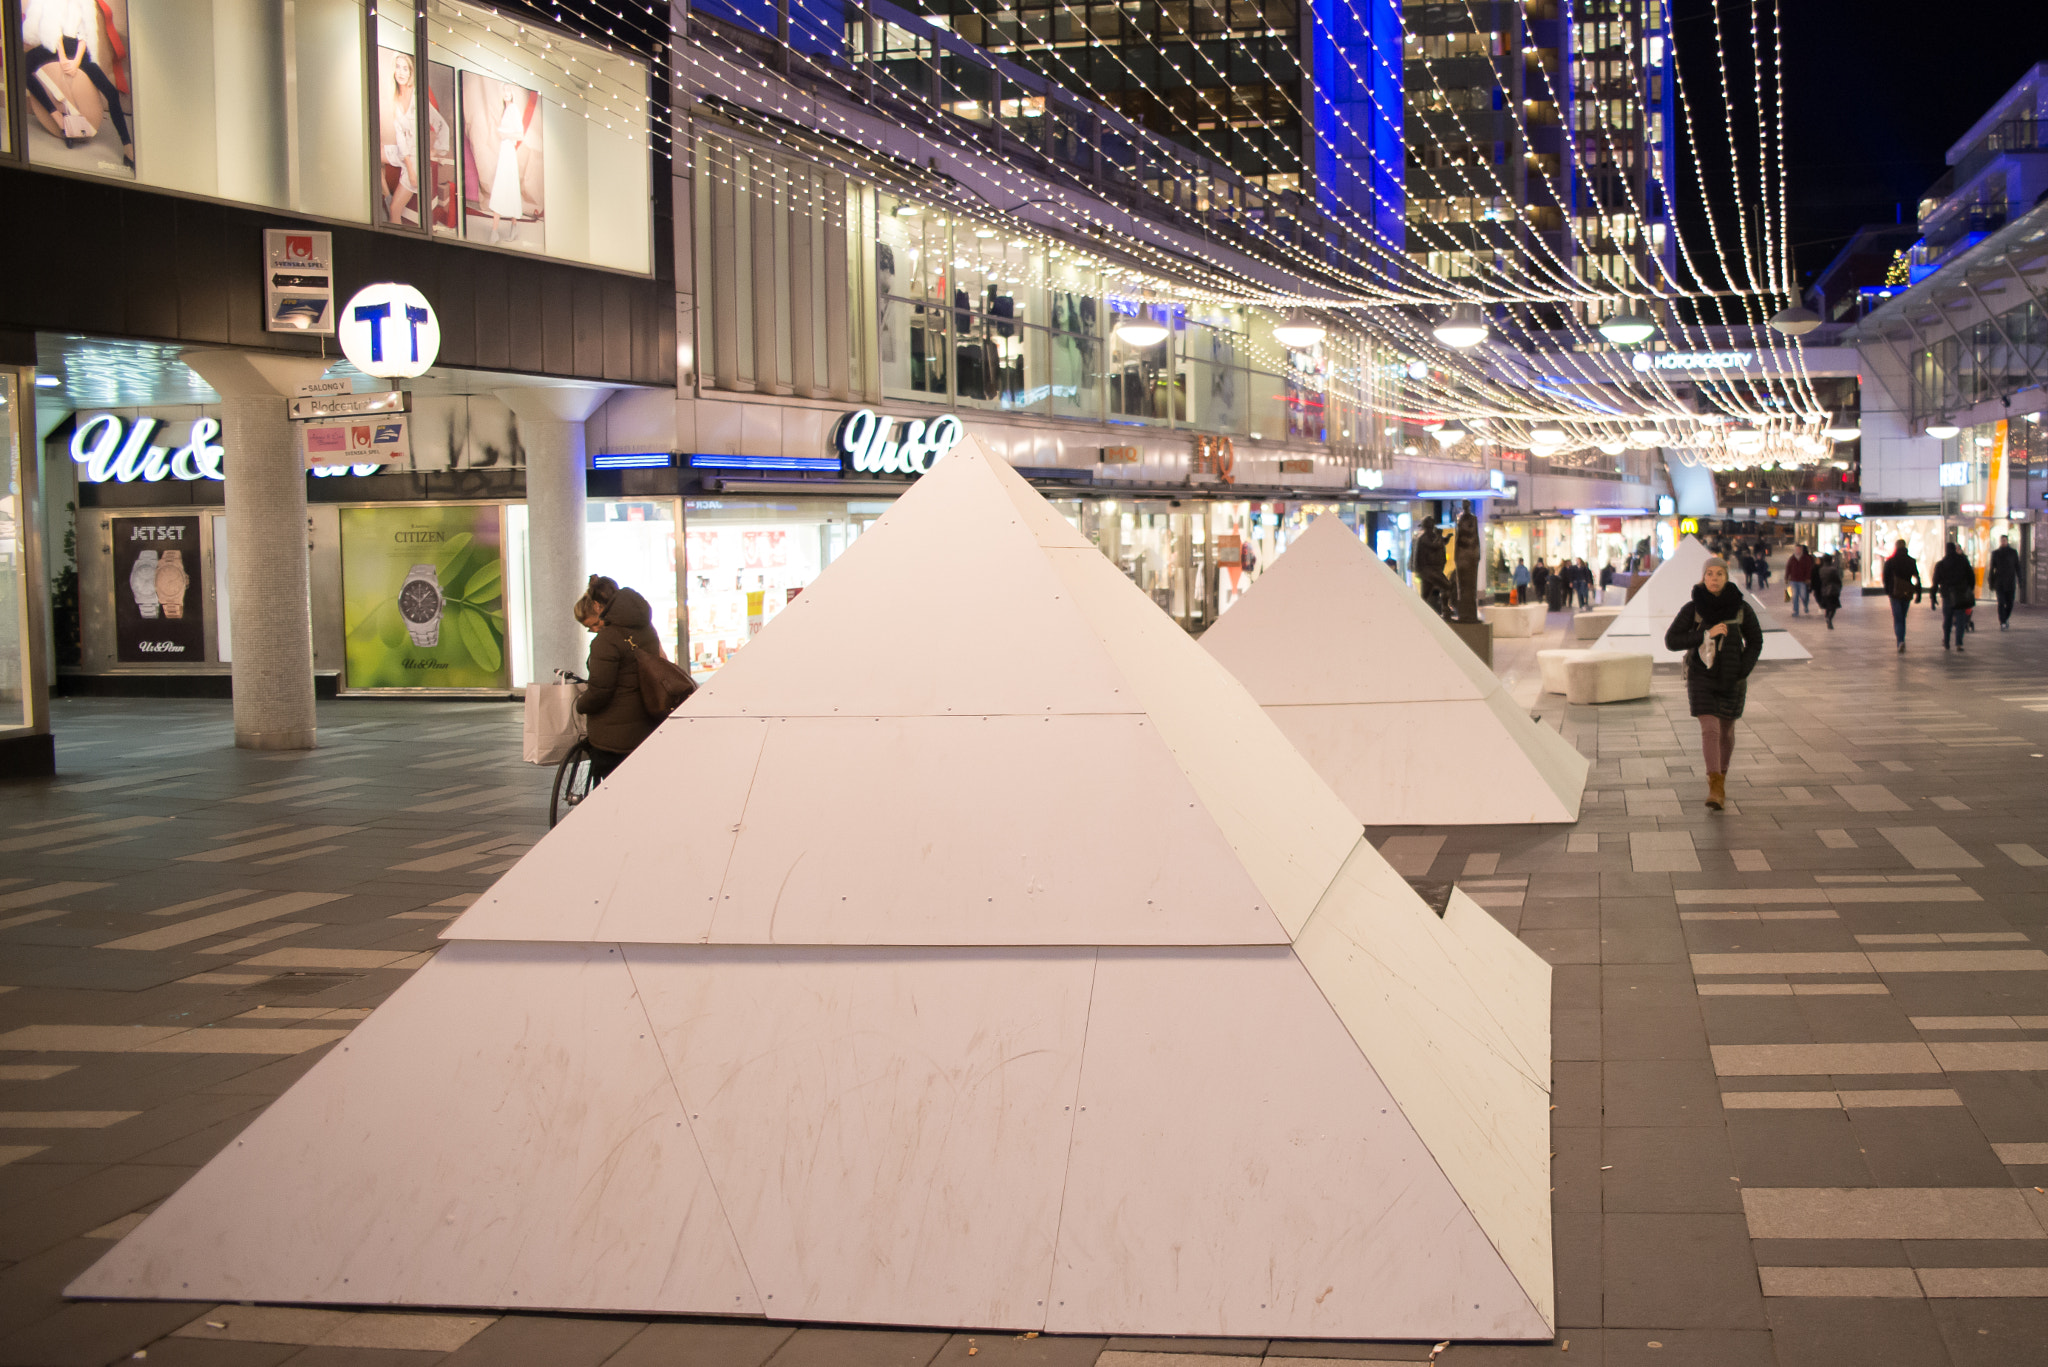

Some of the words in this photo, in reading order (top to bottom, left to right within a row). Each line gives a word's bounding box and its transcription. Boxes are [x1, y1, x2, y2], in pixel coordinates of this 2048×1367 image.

[274, 260, 305, 268] SVENSKA
[354, 301, 390, 362] T
[308, 382, 338, 392] SALONG
[1108, 447, 1137, 462] MQ
[1198, 434, 1235, 484] MQ
[1286, 460, 1309, 473] MQ
[395, 531, 445, 543] CITIZEN
[139, 641, 185, 652] Ur&Penn
